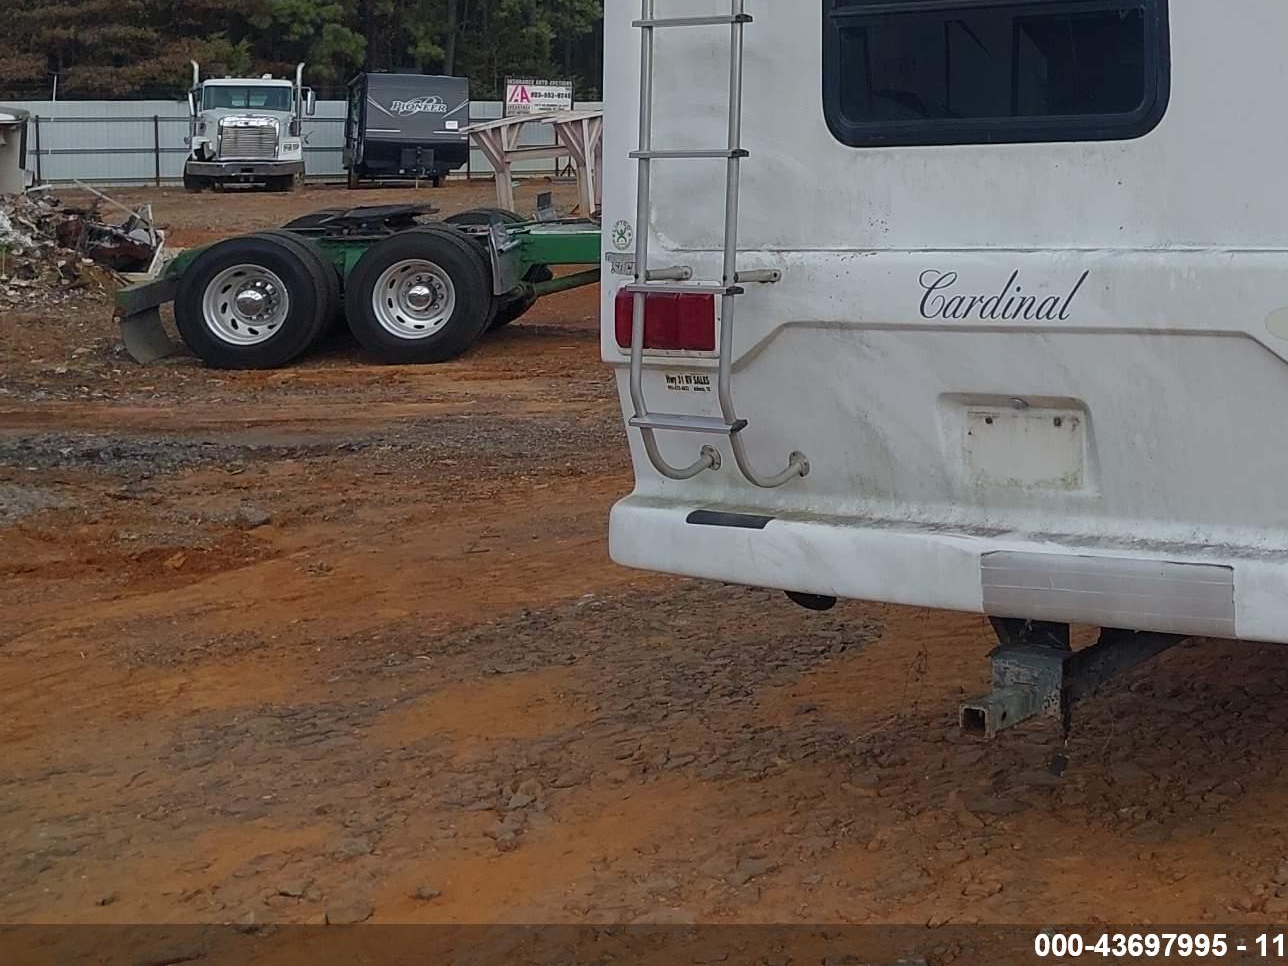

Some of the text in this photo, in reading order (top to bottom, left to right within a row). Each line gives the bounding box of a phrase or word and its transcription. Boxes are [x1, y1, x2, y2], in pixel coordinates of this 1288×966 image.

[390, 100, 448, 113] PIONEER
[918, 269, 1090, 321] Cardinal
[665, 374, 677, 386] Hwy
[678, 375, 684, 385] 31
[693, 375, 710, 385] SALES
